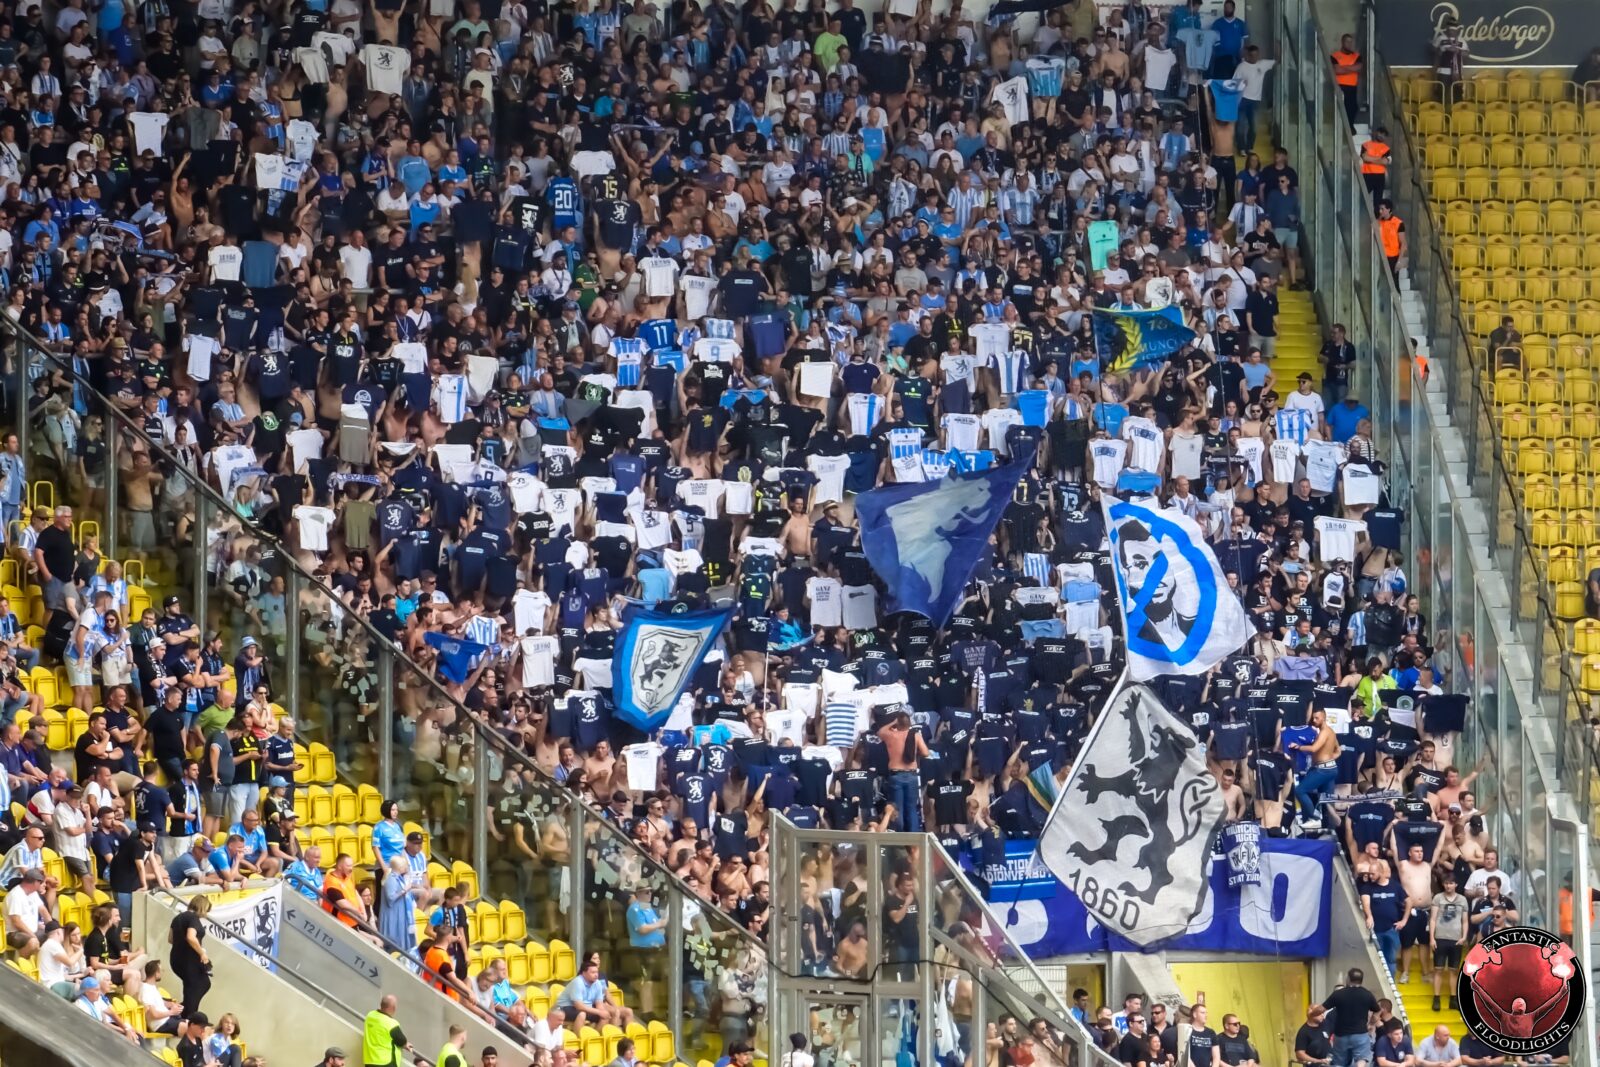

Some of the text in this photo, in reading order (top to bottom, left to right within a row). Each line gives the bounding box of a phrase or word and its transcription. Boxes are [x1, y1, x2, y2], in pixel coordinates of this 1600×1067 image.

[555, 190, 572, 209] 20
[603, 180, 618, 198] 15
[653, 325, 668, 346] 11
[1069, 868, 1140, 931] 1860
[303, 919, 316, 934] T2
[322, 934, 335, 948] T3
[354, 955, 366, 970] T1
